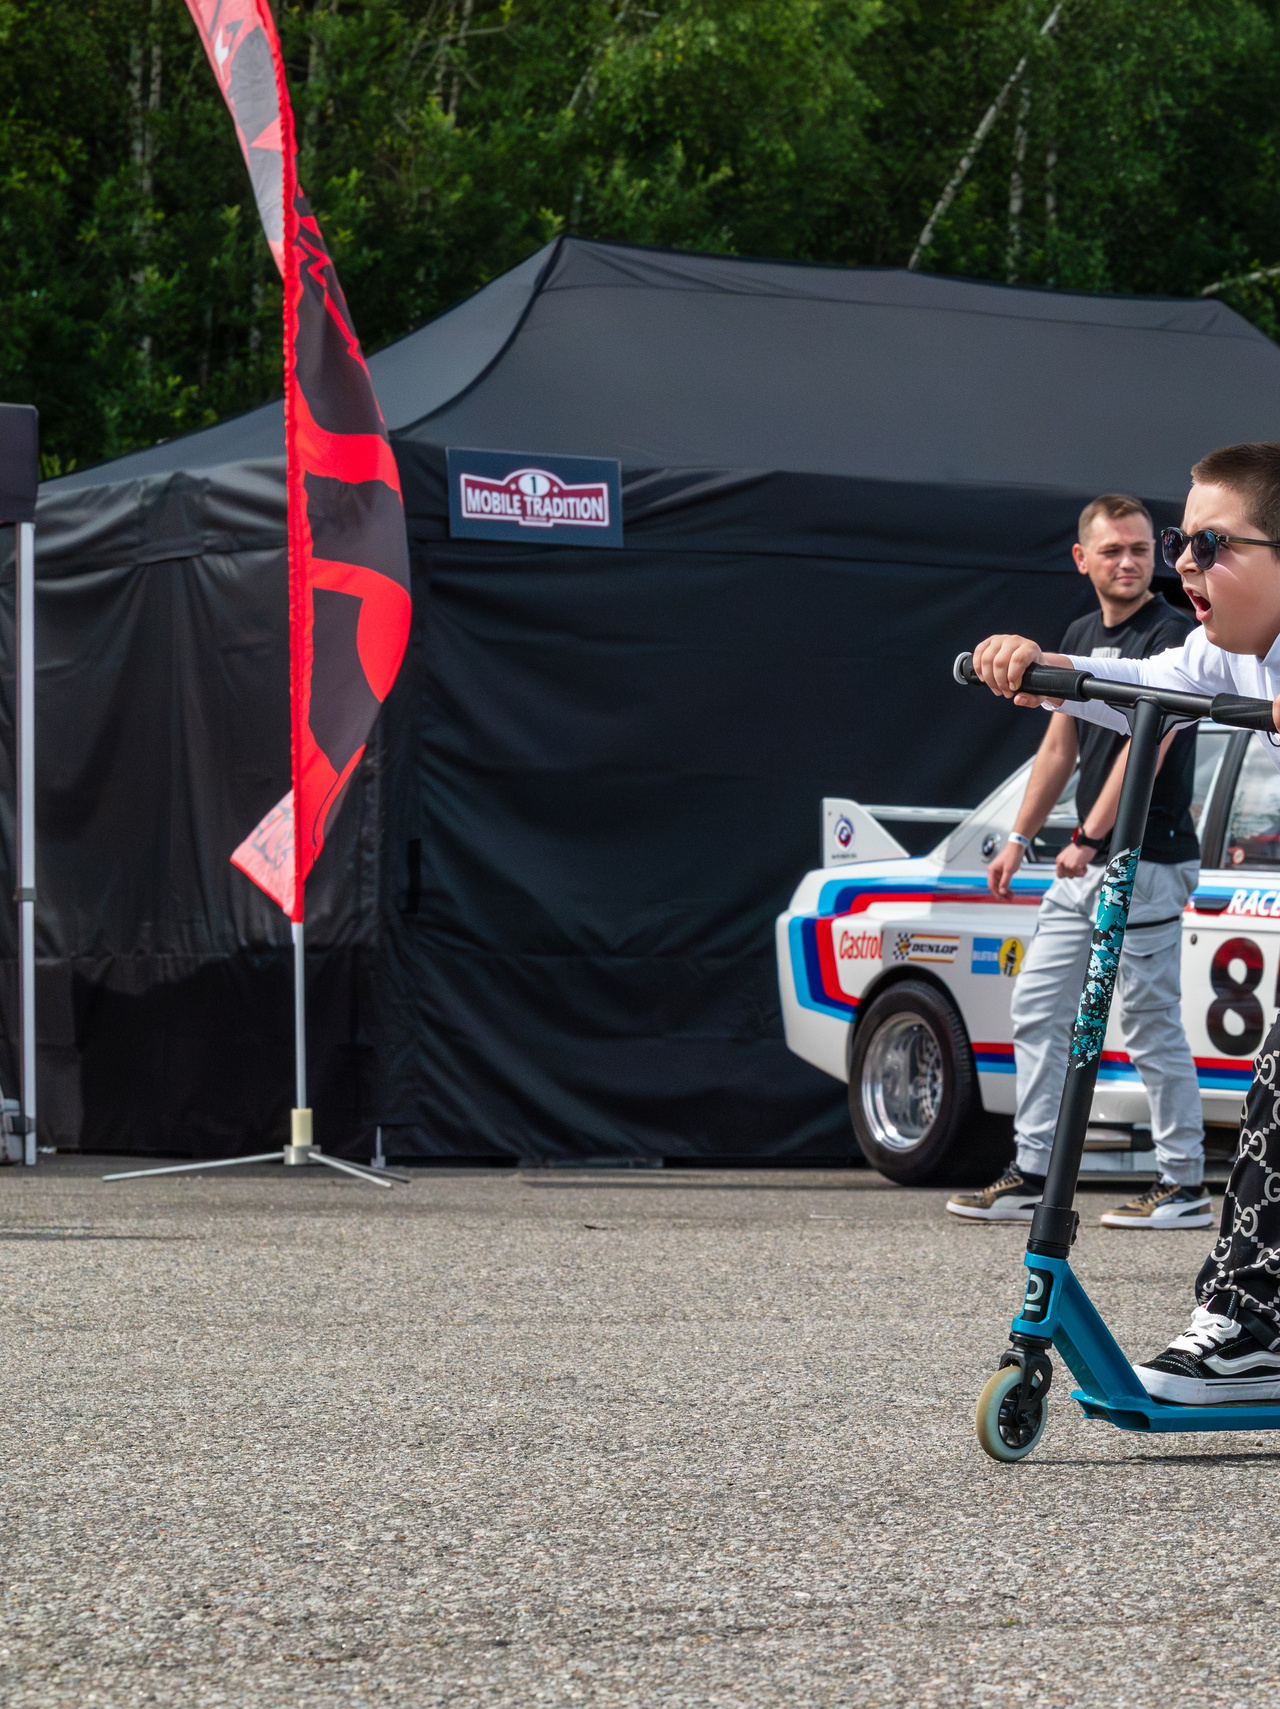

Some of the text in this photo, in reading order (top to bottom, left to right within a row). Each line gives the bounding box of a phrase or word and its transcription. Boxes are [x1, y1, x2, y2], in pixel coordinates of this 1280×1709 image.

[466, 487, 604, 520] MOBILE TRADITION
[838, 930, 885, 960] Castrol
[912, 943, 959, 955] DUNLOP
